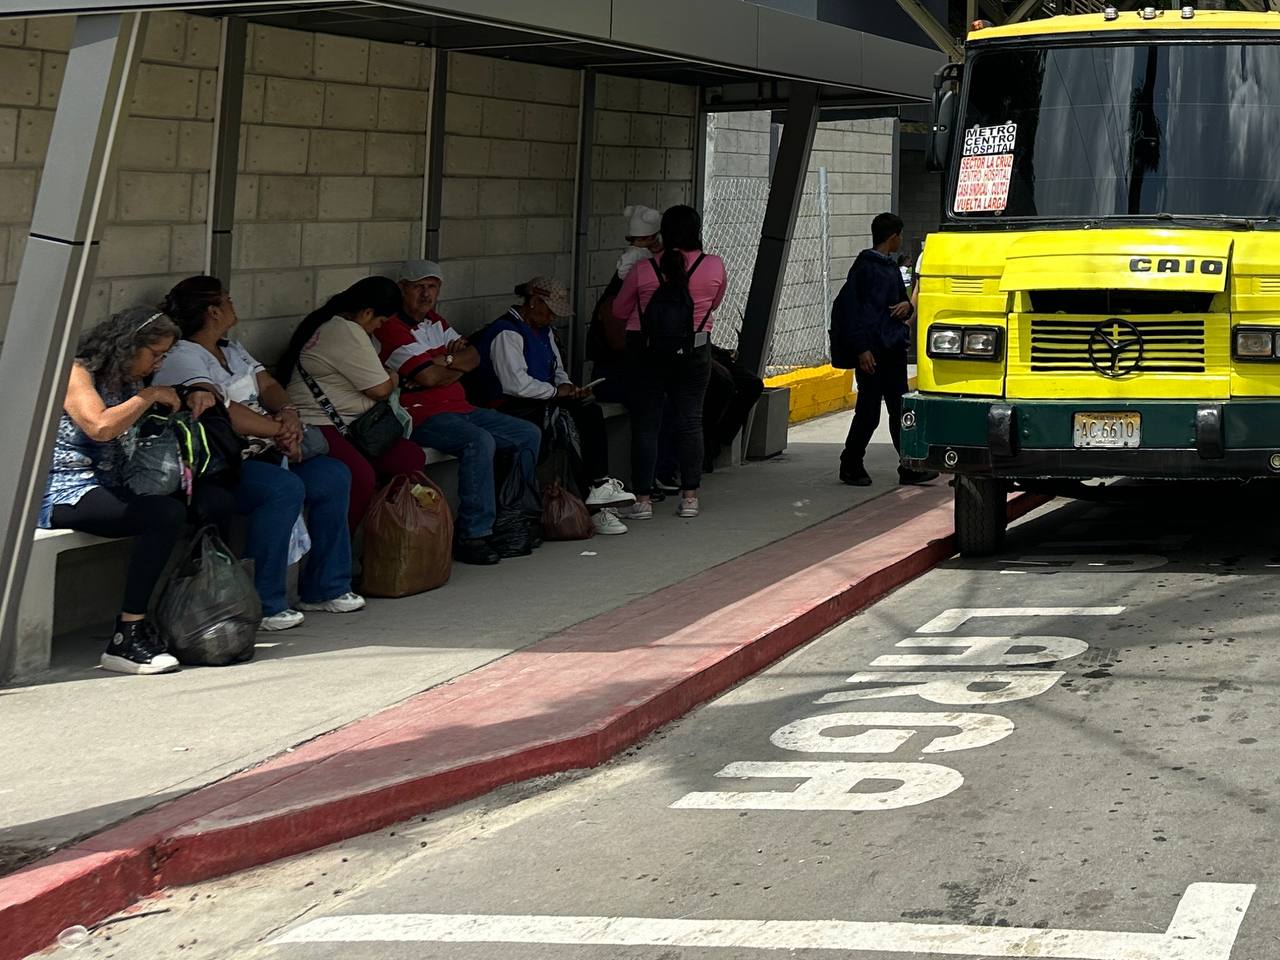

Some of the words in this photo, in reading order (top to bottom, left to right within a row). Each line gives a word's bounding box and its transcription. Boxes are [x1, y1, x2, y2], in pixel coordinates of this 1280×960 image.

[966, 125, 1016, 138] METRO
[965, 134, 1015, 147] CENTRO
[965, 143, 1014, 155] HOSPITAL
[962, 157, 986, 170] SECTOR
[987, 156, 995, 169] LA
[996, 155, 1013, 168] CRUZ
[960, 170, 982, 183] CENTRO
[983, 168, 1009, 181] HOSPITAL
[957, 198, 982, 211] VUELTA
[983, 197, 1007, 210] LARGA
[1129, 258, 1224, 275] CAIO
